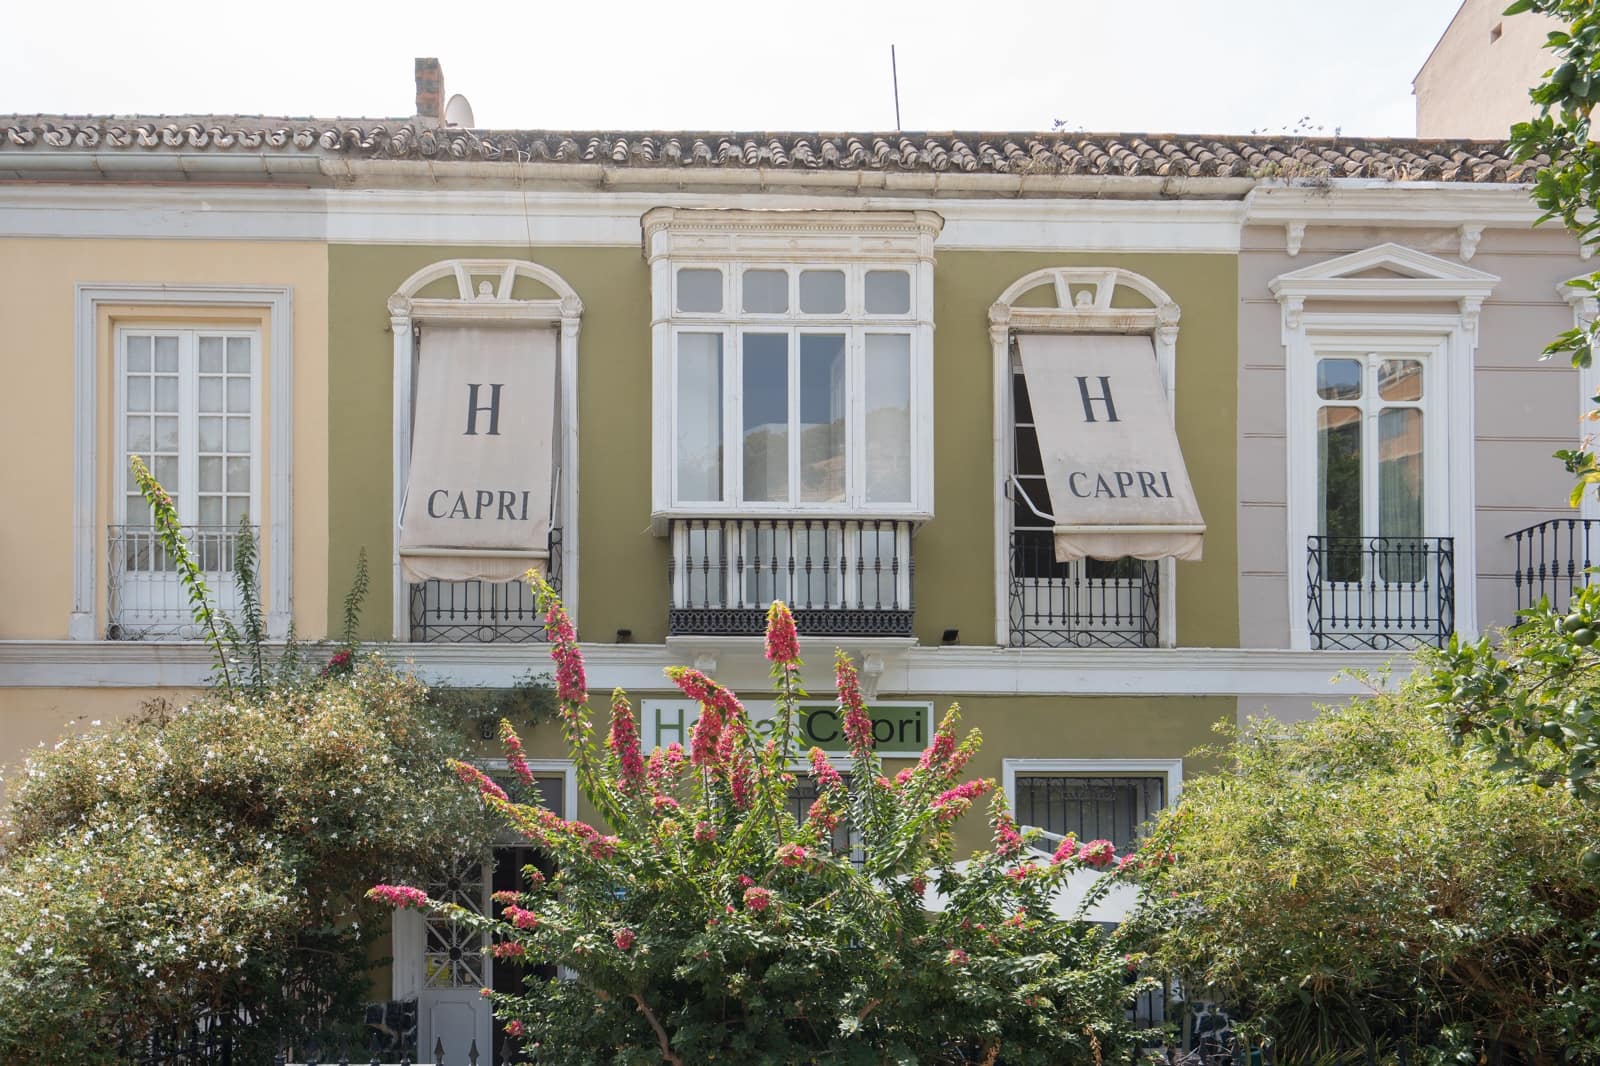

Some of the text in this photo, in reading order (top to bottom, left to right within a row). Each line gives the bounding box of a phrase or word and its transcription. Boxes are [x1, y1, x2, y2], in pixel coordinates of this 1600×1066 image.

[463, 383, 505, 436] H
[1074, 375, 1122, 423] H
[427, 489, 532, 521] CAPRI
[1068, 471, 1175, 499] CAPRI
[806, 710, 921, 750] Cpri
